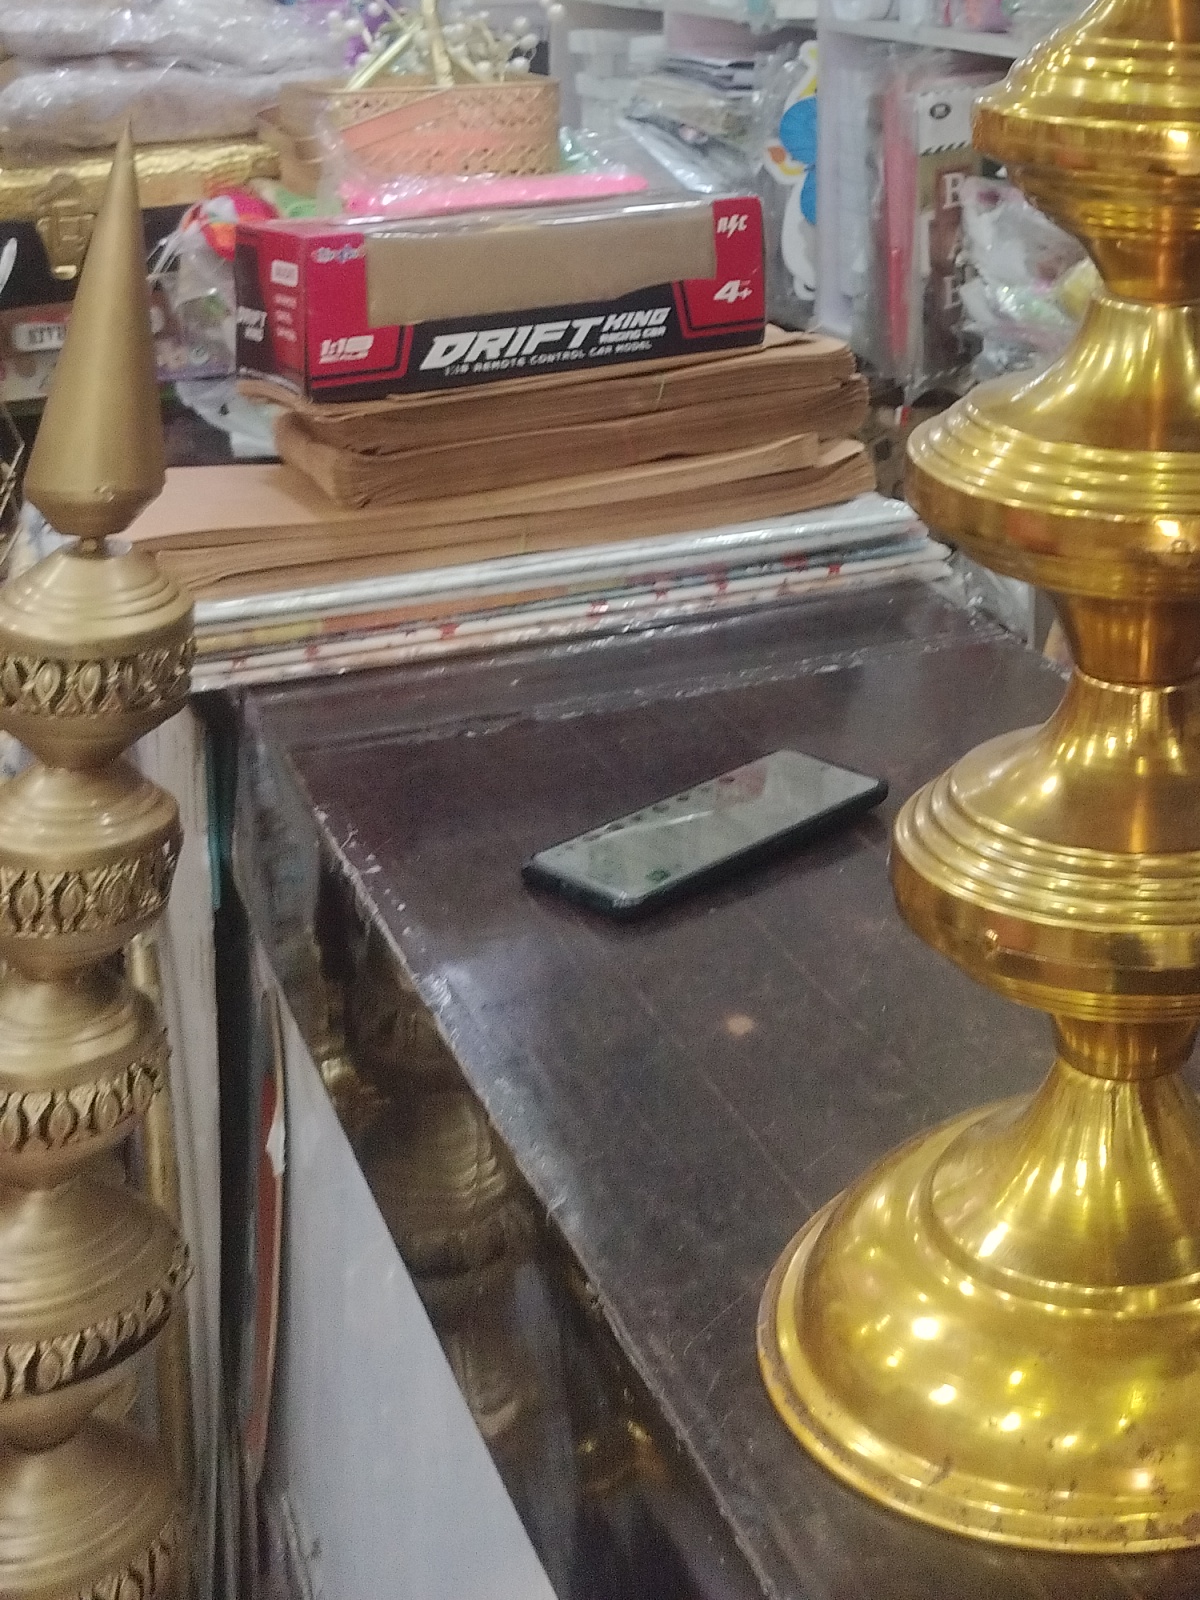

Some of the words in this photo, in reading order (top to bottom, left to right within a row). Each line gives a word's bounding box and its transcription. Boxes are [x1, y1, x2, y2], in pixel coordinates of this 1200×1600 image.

[418, 315, 606, 372] DRIFT
[602, 306, 672, 333] KING
[473, 356, 527, 373] REMOTE
[530, 349, 586, 367] CONTROL
[589, 345, 615, 359] CAR
[616, 340, 653, 356] MODEL
